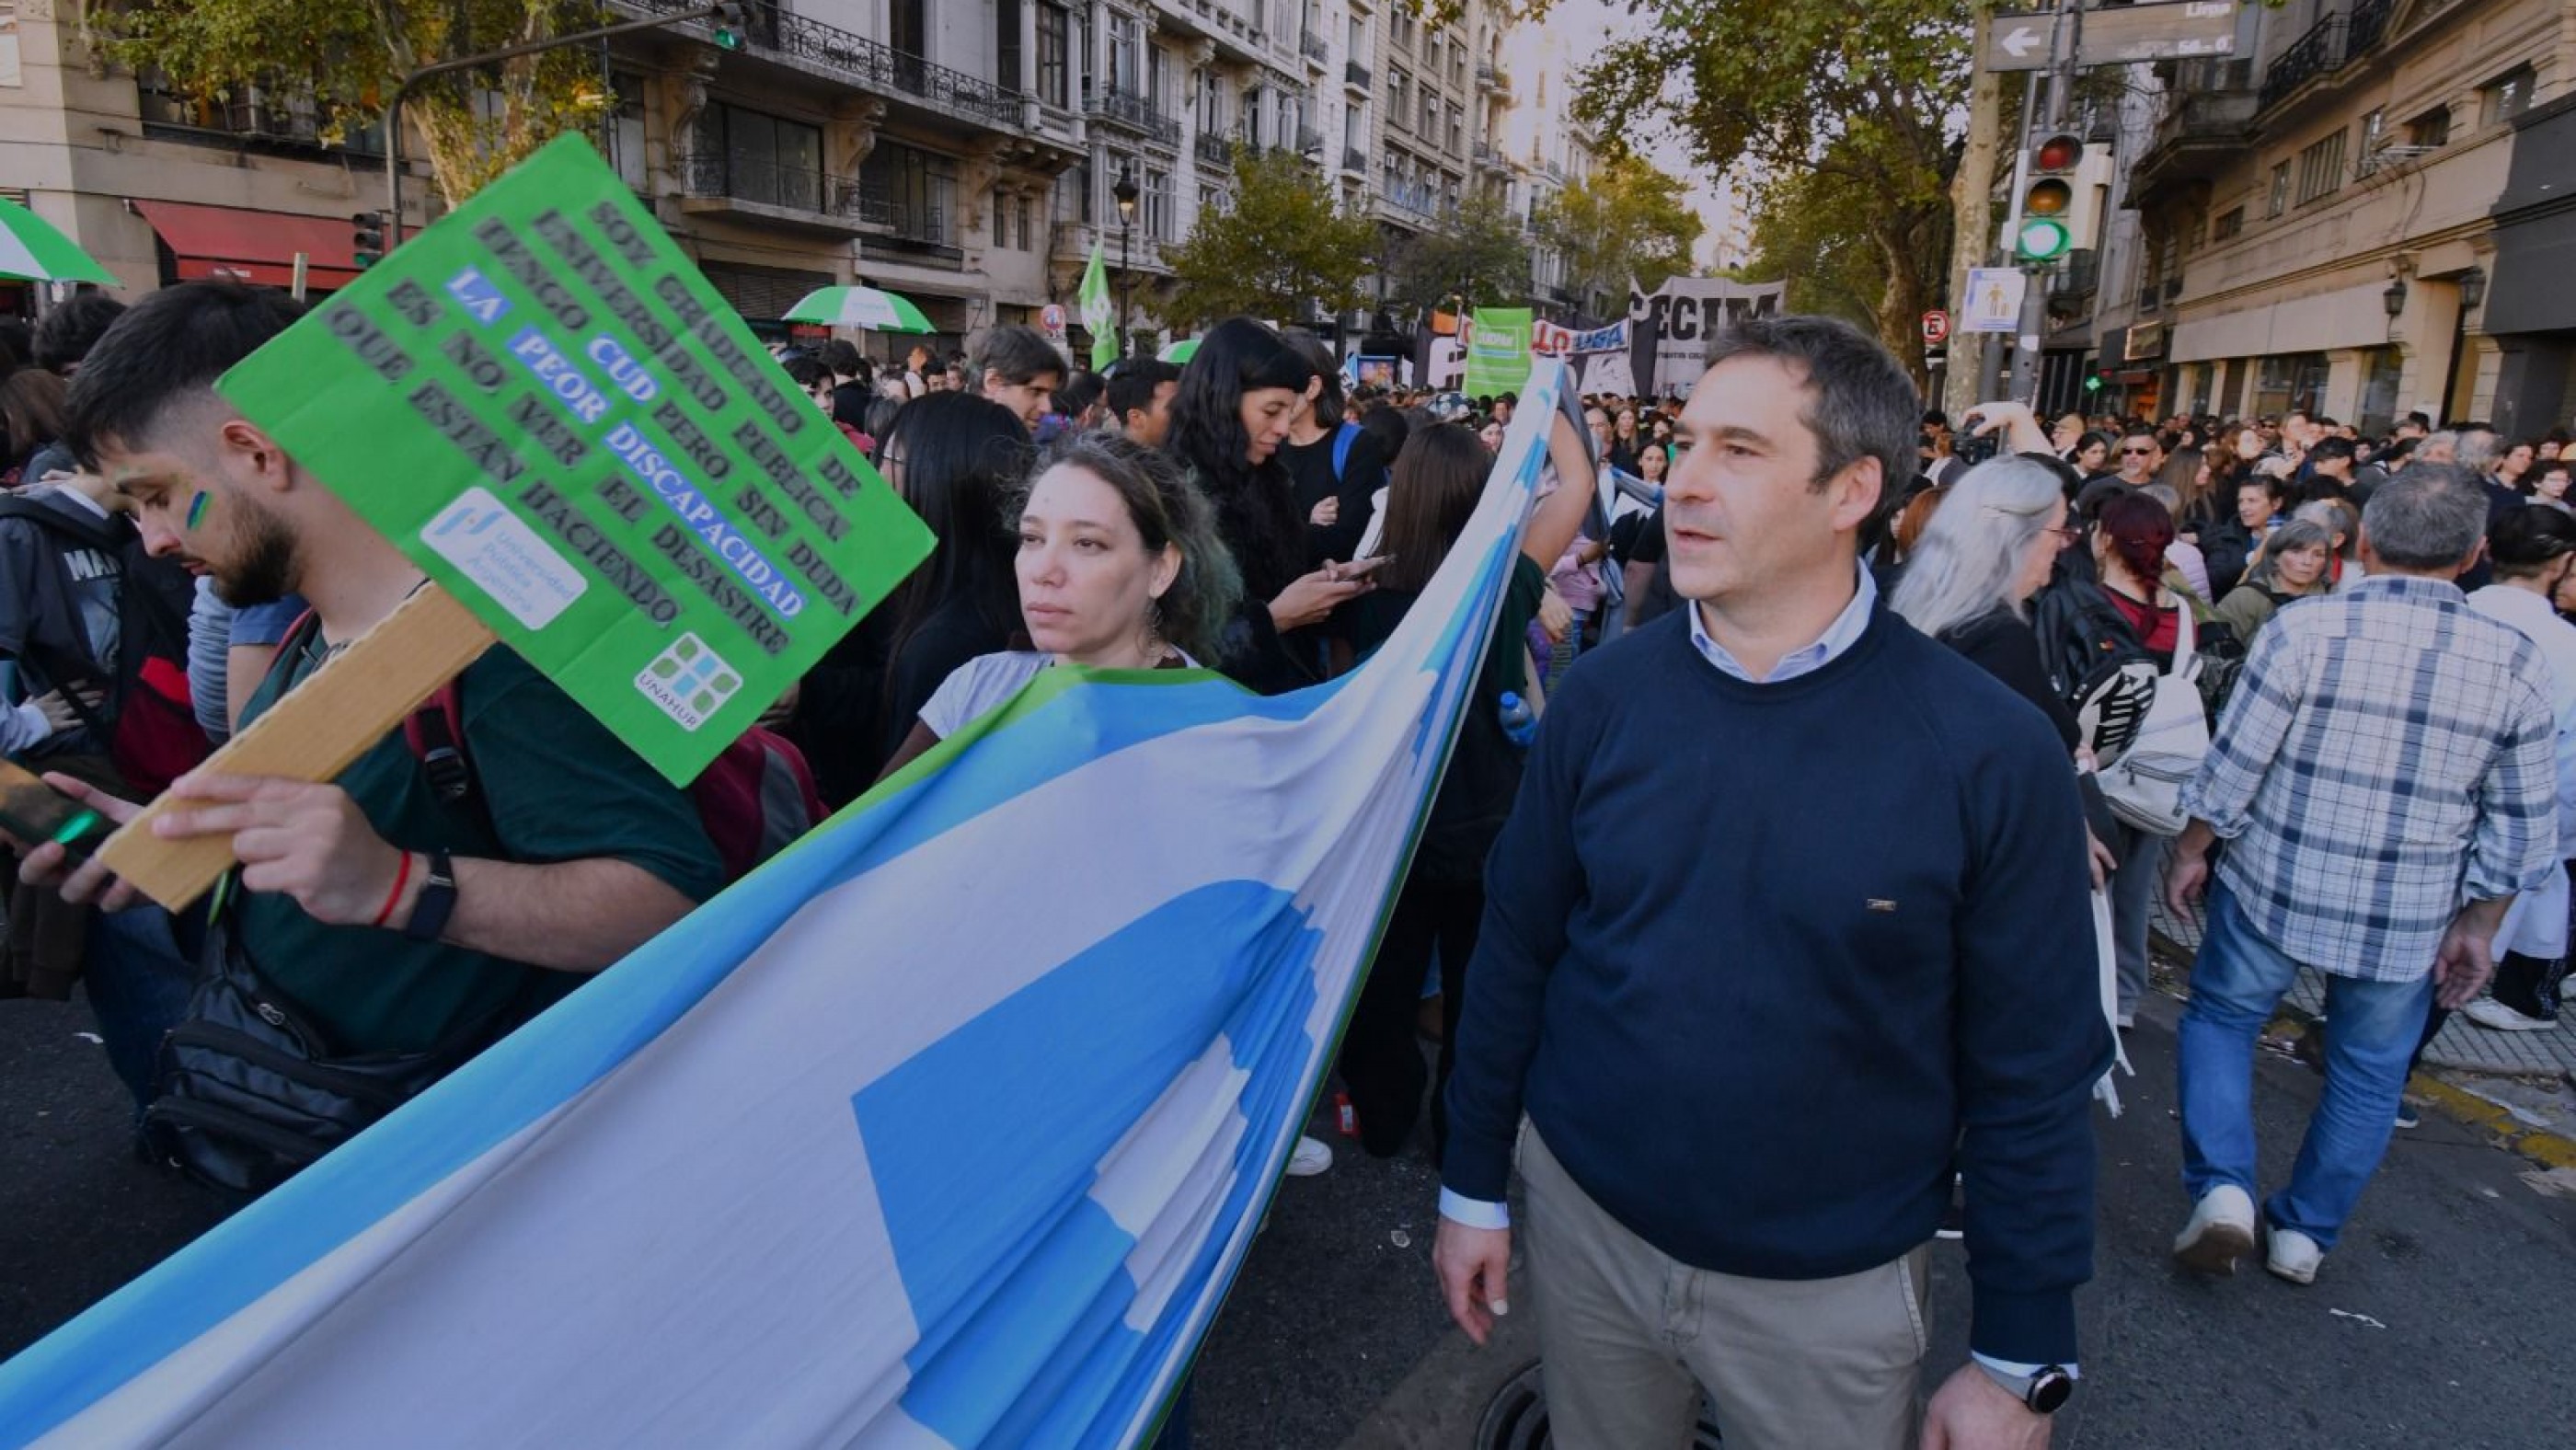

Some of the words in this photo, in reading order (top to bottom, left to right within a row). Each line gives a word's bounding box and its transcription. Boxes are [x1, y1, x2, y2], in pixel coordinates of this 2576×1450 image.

[449, 270, 502, 321] LA
[515, 333, 606, 423] PEOR
[606, 424, 803, 616] DISCAPACIDAD
[477, 218, 588, 330] TENGO
[589, 337, 657, 400] CUD
[653, 401, 730, 479] PERO
[736, 486, 788, 538] SIN
[788, 539, 857, 616] DUDA
[533, 210, 727, 409] UNIVERSIDAD
[593, 201, 656, 269] SOY
[655, 273, 802, 434] GRADUADO
[819, 455, 861, 497] DE
[1631, 292, 1778, 340] ECIM
[331, 308, 412, 380] QUE
[517, 482, 678, 623] HACIENDO
[386, 279, 440, 326] ES
[443, 331, 506, 387] NO
[512, 396, 588, 466] VER
[601, 476, 646, 523] EL
[652, 524, 788, 654] DESASTRE
[495, 531, 576, 598] Universidad
[638, 674, 696, 726] UNAHUR
